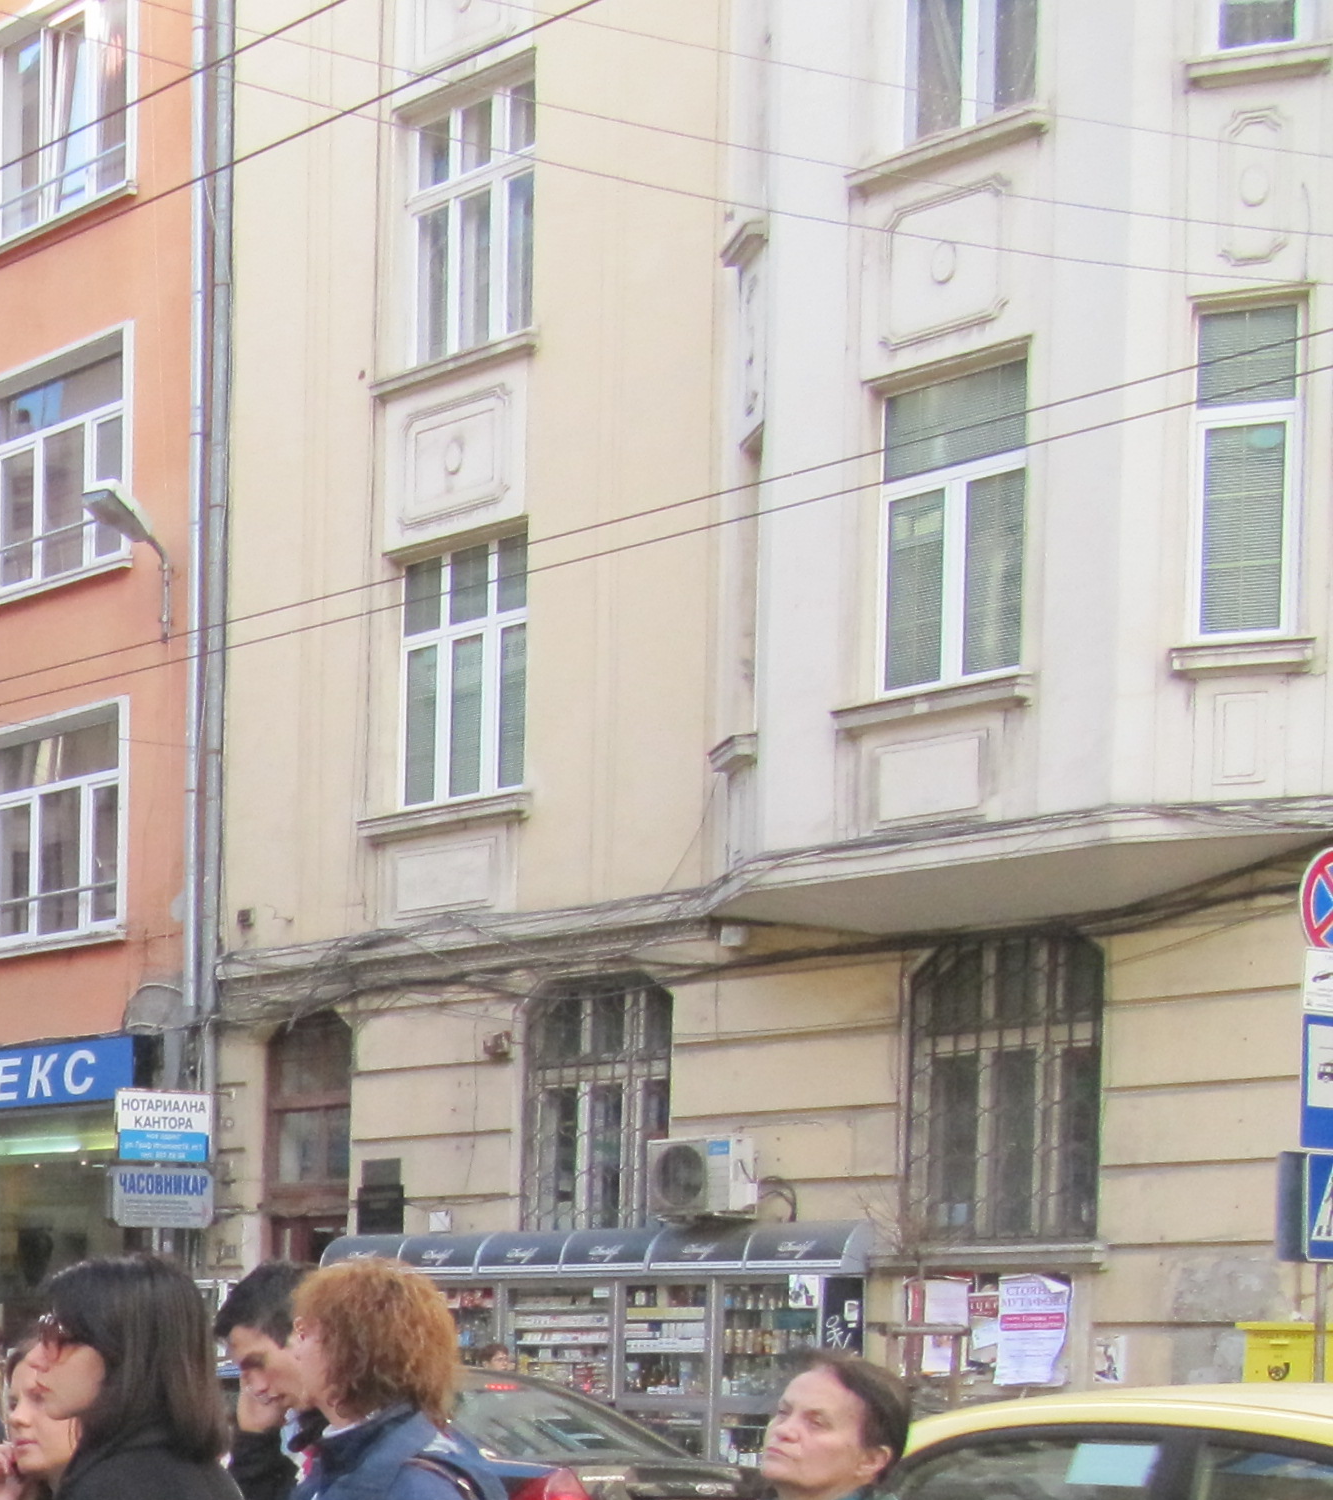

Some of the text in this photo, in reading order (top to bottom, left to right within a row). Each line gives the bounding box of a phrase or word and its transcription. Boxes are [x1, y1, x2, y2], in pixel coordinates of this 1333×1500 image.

[121, 1098, 207, 1114] НОТАРИАЛНА
[134, 1115, 194, 1130] КАНТОРА
[119, 1172, 209, 1196] ЧАСОВНИКАР
